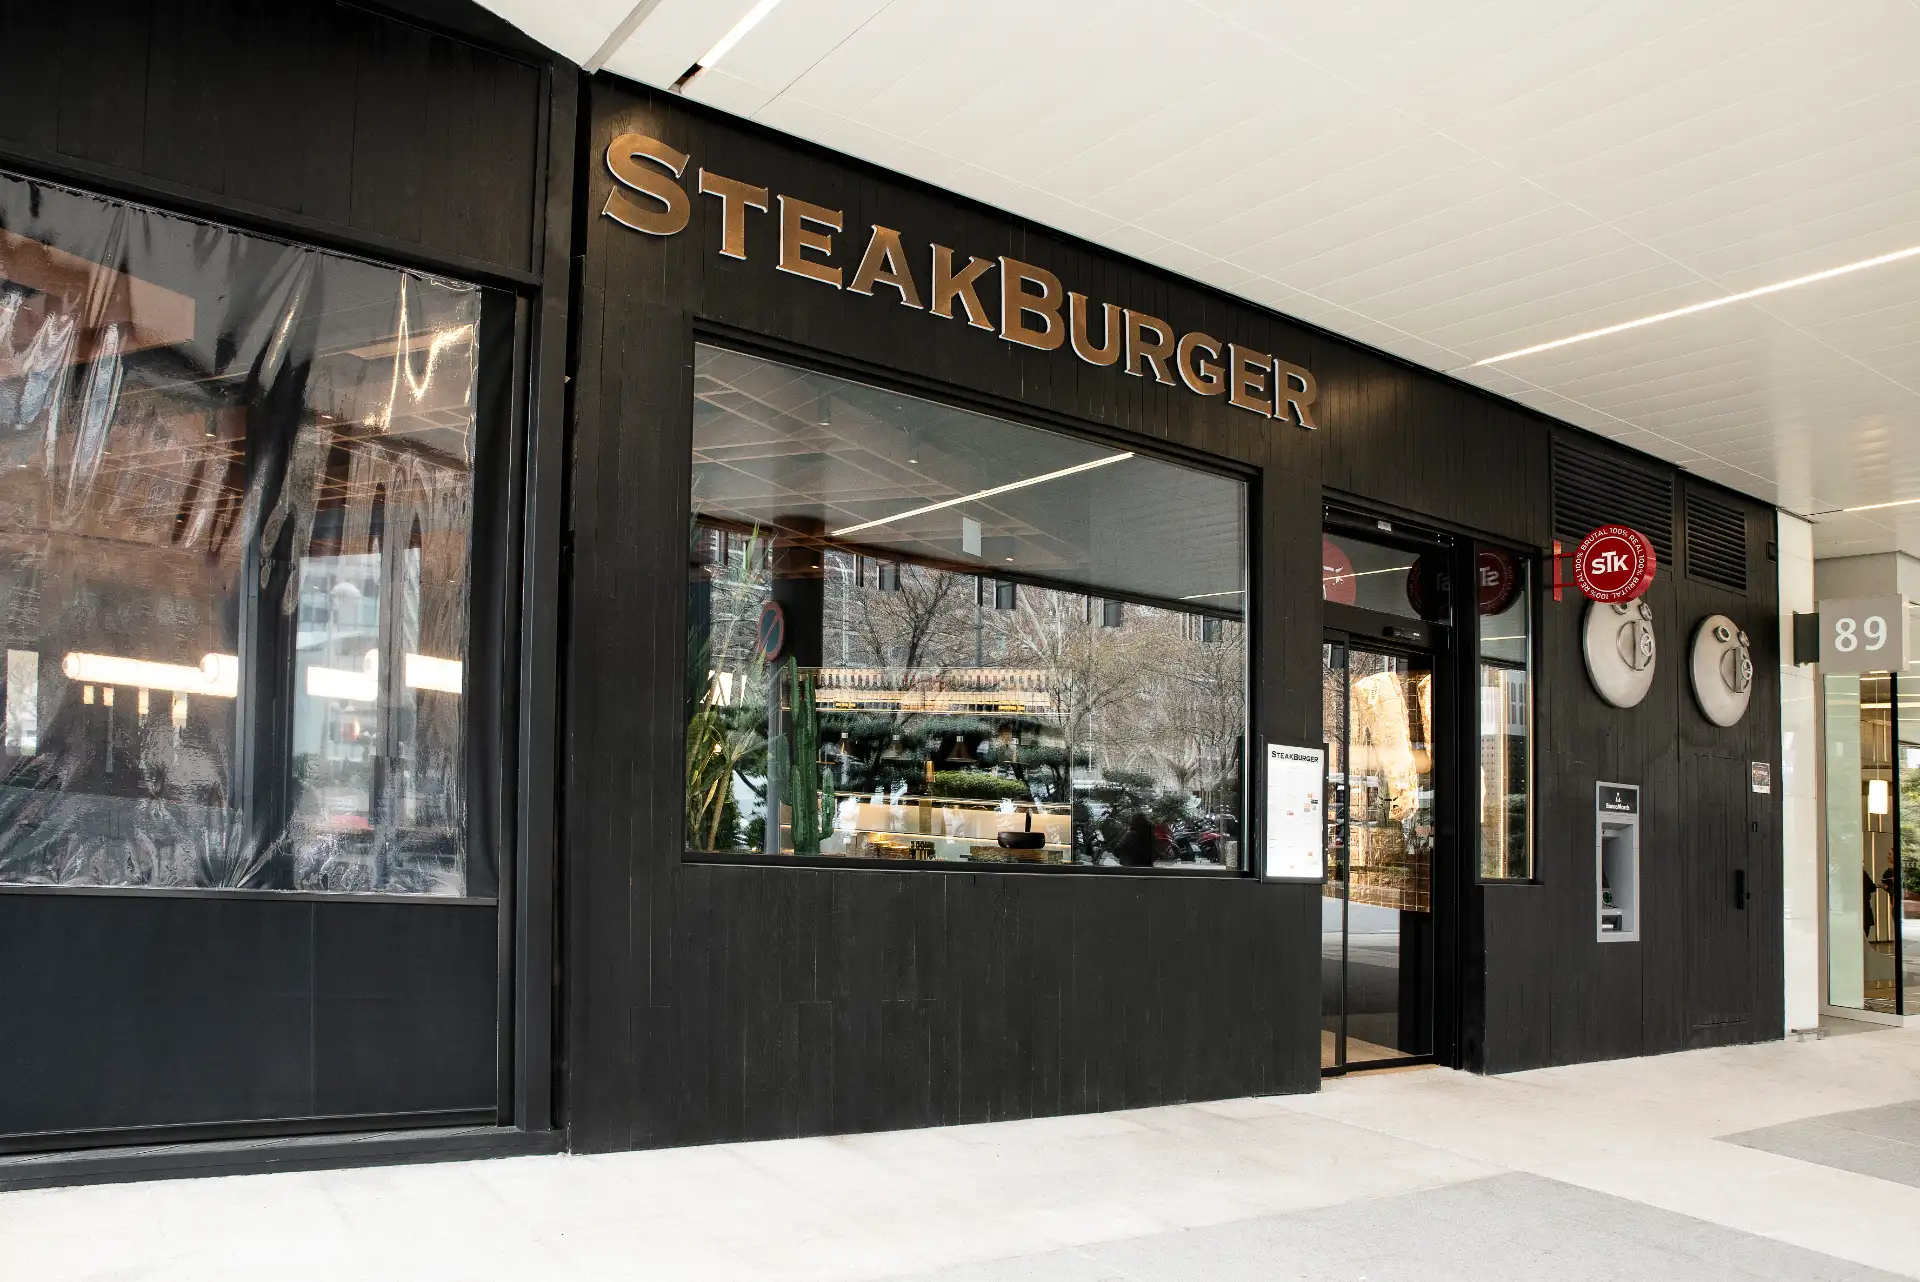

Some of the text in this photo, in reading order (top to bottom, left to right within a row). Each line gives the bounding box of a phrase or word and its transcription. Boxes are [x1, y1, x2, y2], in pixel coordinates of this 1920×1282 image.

[602, 133, 1317, 430] STEAKBURGER
[1575, 527, 1645, 600] BRUTAL 100% REAL 100% BRUTAL 100% REAL 100%
[1834, 615, 1887, 653] 89
[1271, 750, 1319, 763] STEAKBURGER
